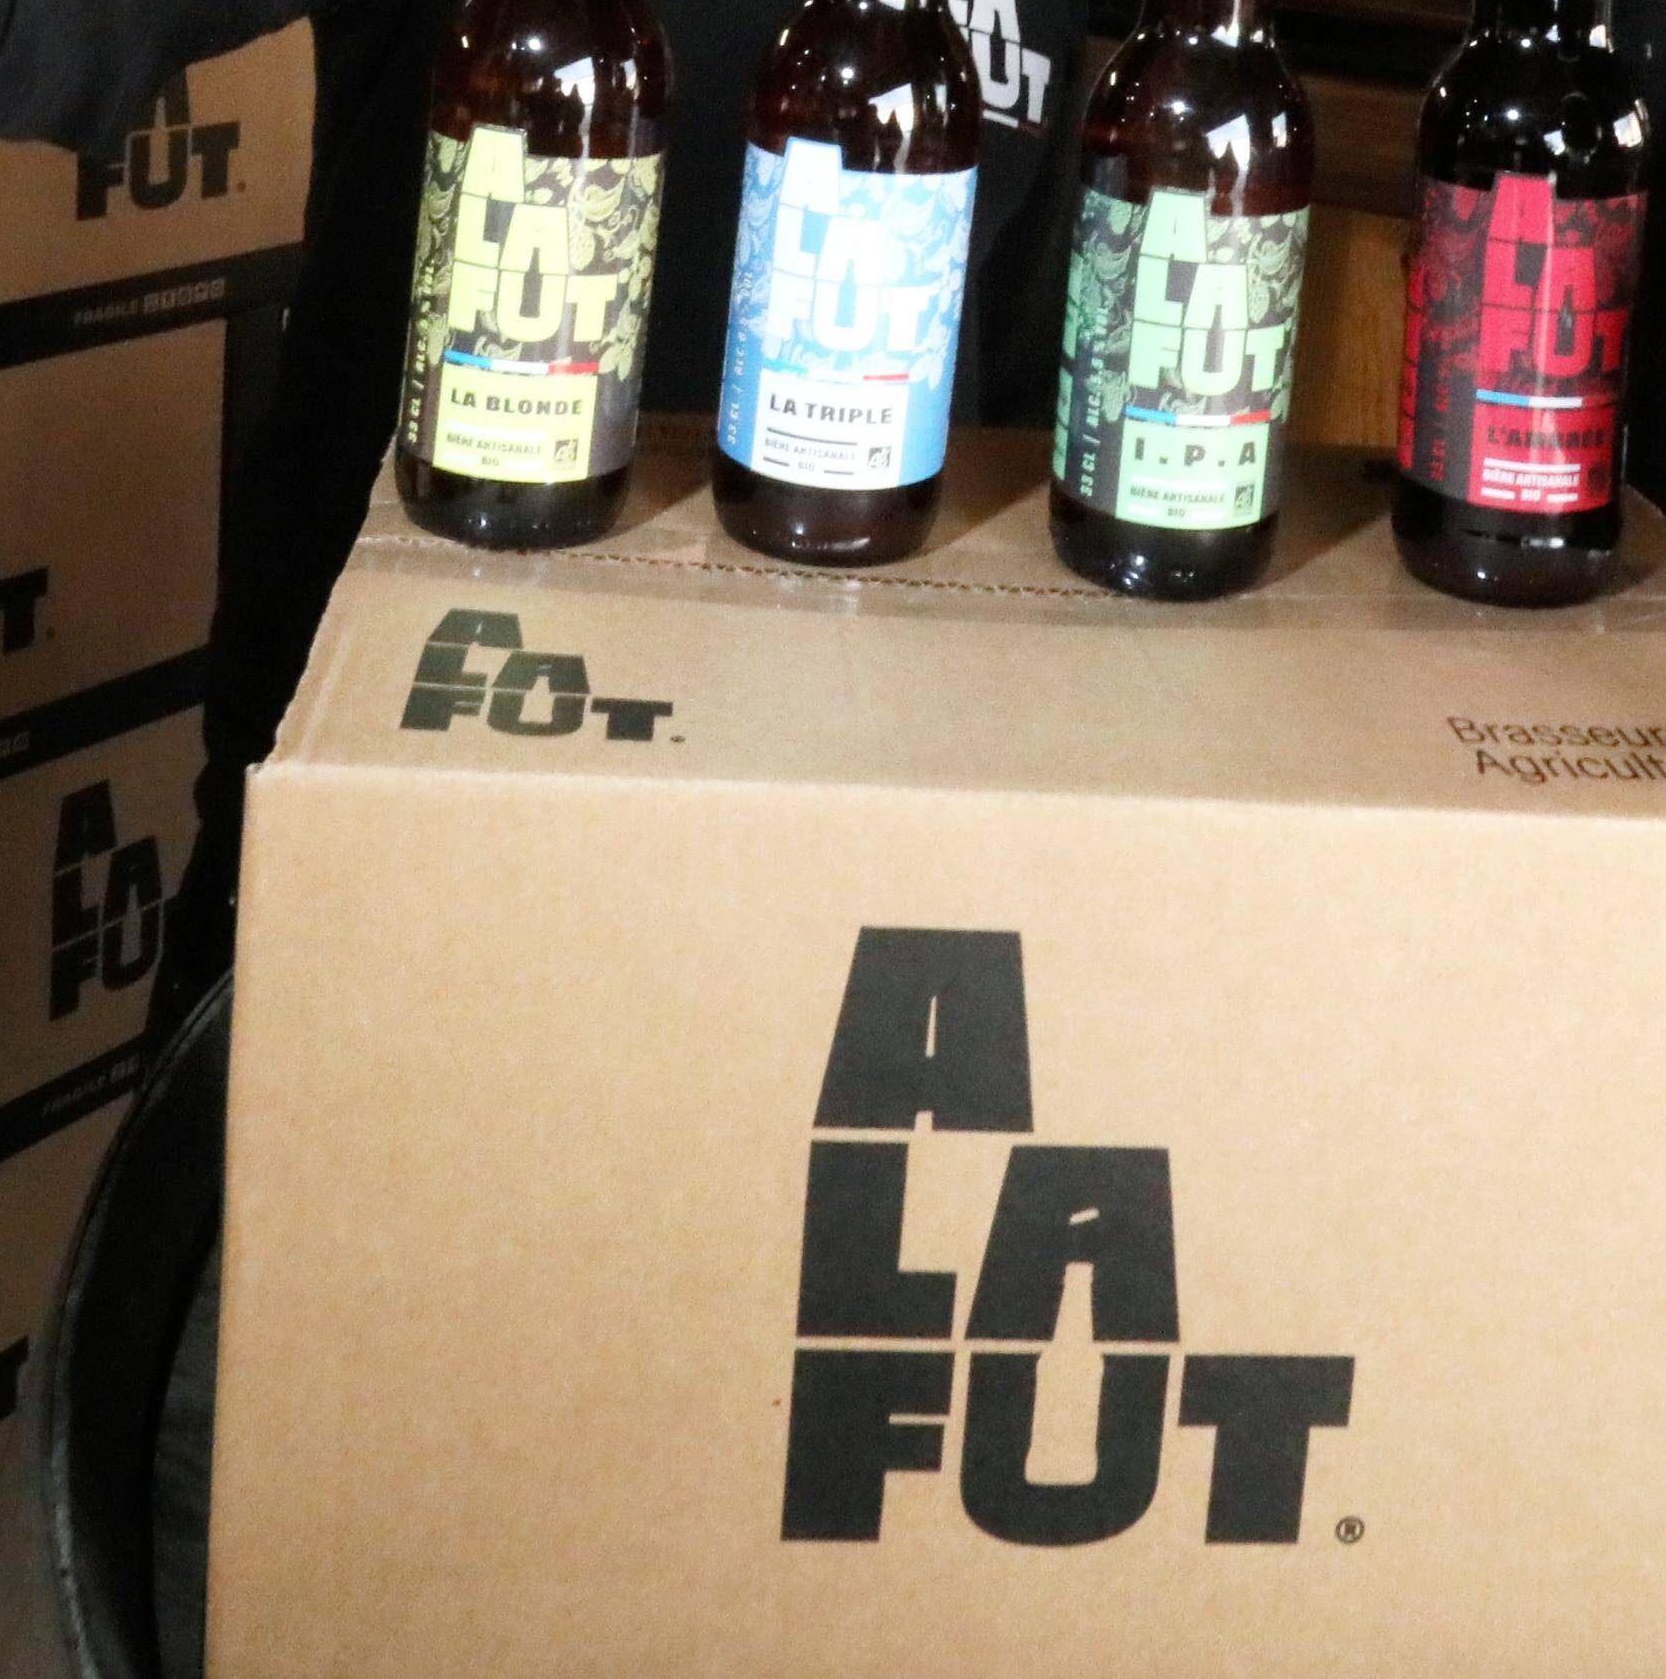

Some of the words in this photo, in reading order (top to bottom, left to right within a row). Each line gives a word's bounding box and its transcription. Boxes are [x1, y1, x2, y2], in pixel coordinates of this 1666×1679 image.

[454, 193, 569, 275] LA
[1133, 254, 1248, 330] LA
[450, 388, 477, 410] LA
[485, 394, 584, 417] BLONDE
[769, 393, 799, 416] LA
[804, 403, 894, 425] TRIPLE
[813, 925, 1034, 1133] A
[796, 1138, 1180, 1344] LA
